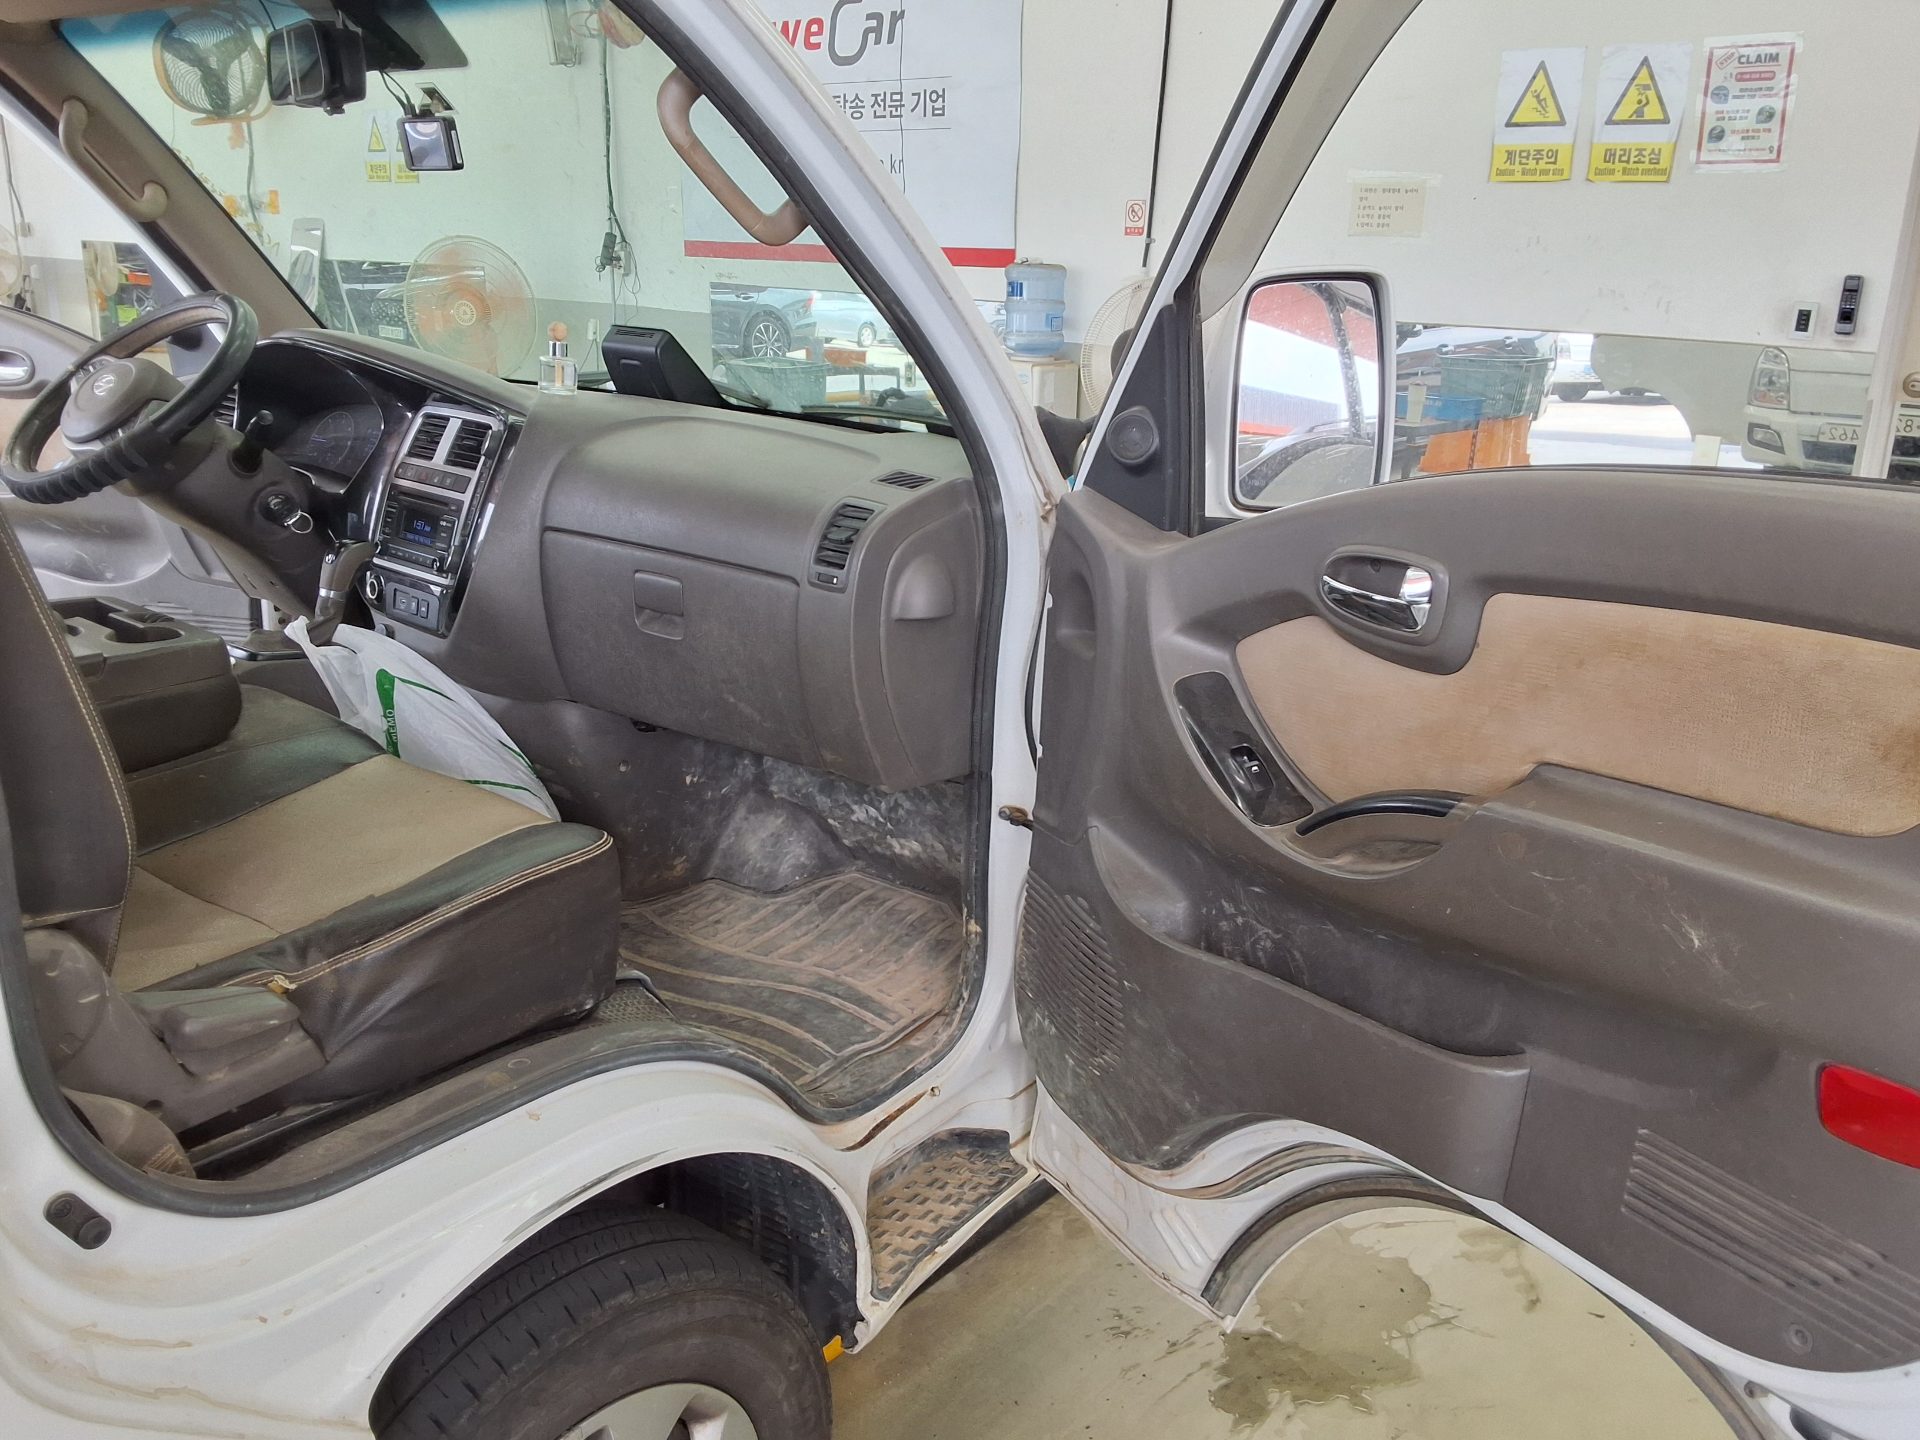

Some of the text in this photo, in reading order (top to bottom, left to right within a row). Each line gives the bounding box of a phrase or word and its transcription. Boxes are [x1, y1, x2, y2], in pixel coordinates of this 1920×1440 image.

[1737, 52, 1780, 65] CLAIM
[870, 91, 905, 119] 전문
[911, 88, 946, 118] 기업
[1504, 149, 1559, 166] 계단주의
[1603, 148, 1662, 165] 머리조심
[1495, 167, 1516, 176] Caution
[1594, 167, 1616, 176] Caution
[386, 709, 398, 742] MEMO
